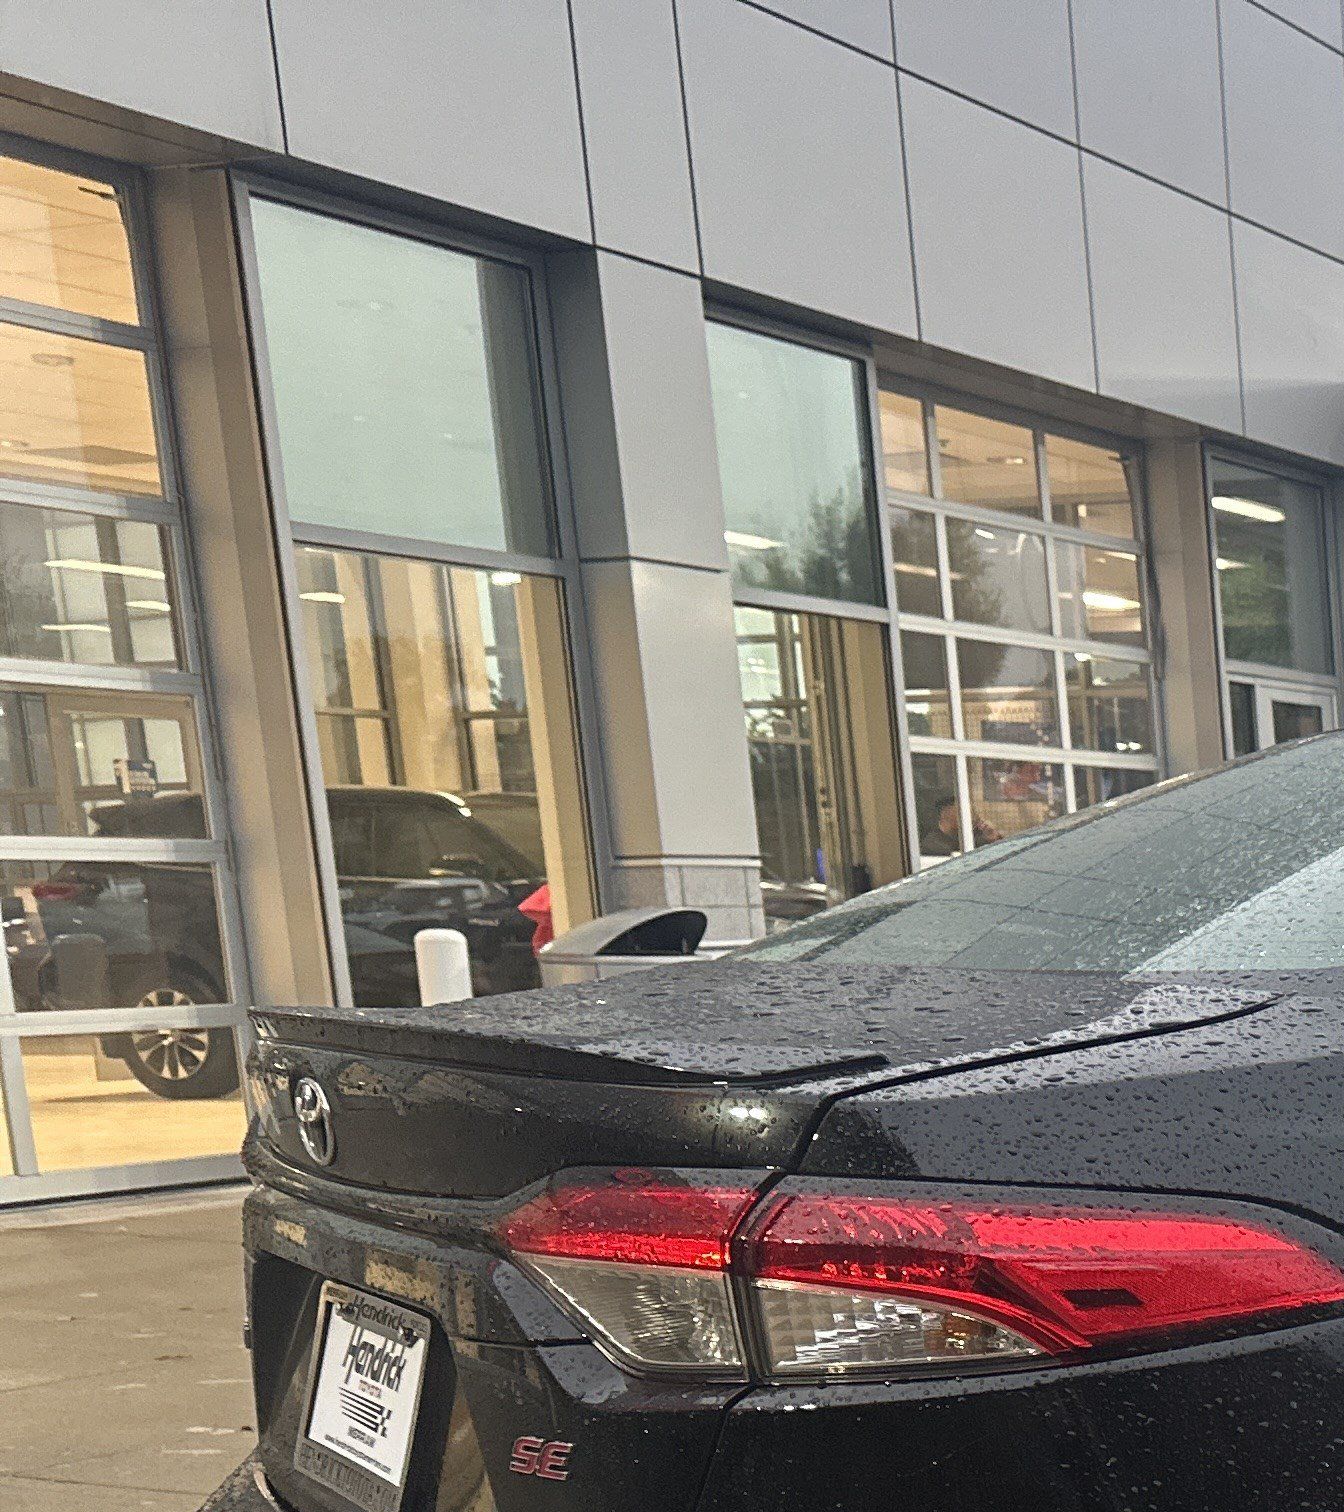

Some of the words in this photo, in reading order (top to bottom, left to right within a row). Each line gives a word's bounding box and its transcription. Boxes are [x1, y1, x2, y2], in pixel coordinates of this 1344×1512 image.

[351, 1293, 405, 1331] Hendrick
[342, 1325, 406, 1392] Hendrick
[509, 1436, 573, 1481] SE
